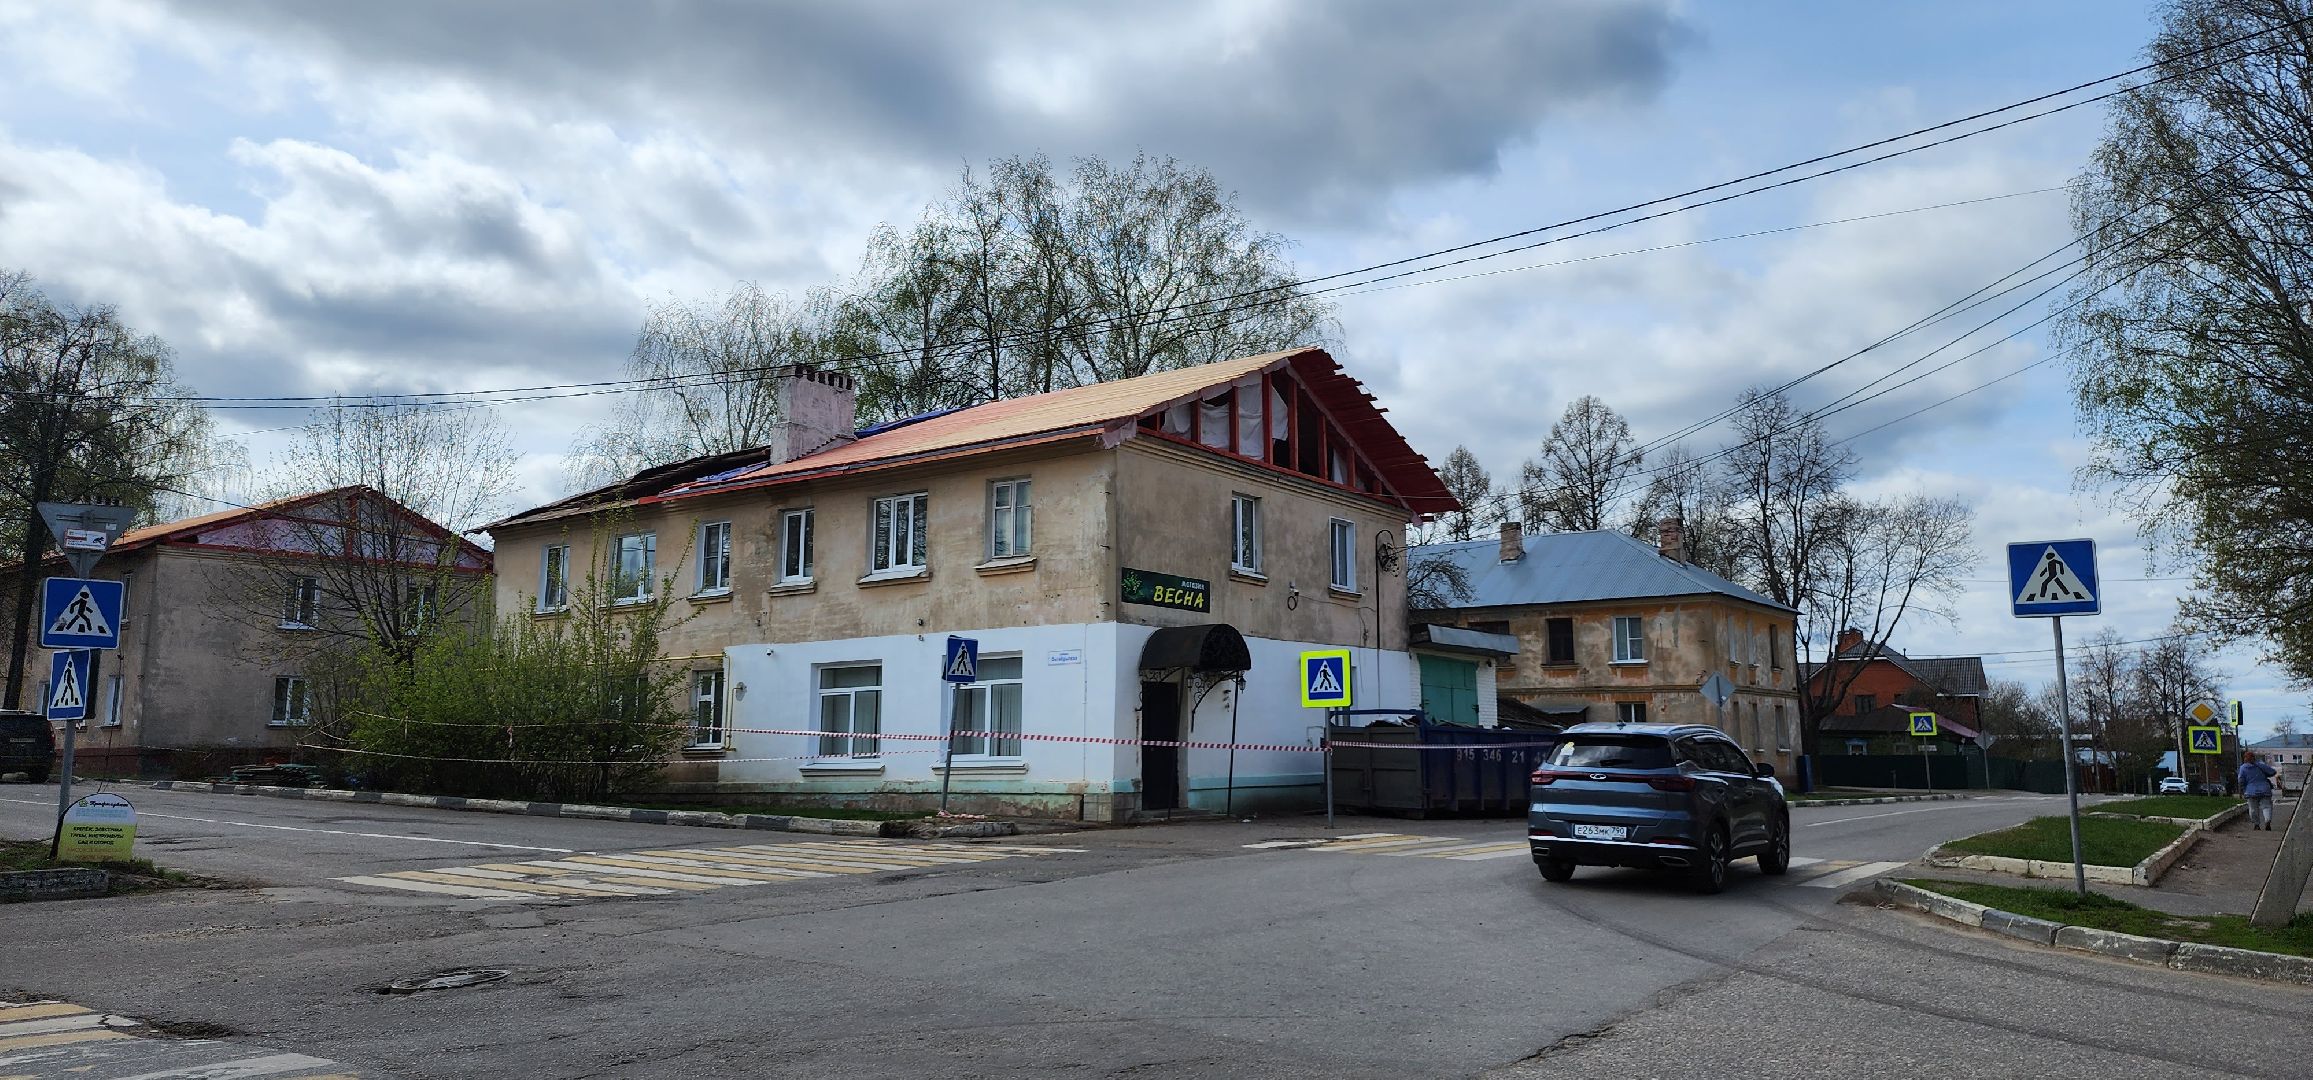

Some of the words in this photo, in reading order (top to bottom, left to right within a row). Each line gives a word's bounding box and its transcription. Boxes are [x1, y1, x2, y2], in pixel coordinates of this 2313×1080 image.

[1153, 585, 1204, 609] ВЕСНА
[1457, 748, 1475, 761] 915
[1483, 749, 1502, 762] 346
[1512, 750, 1525, 764] 21
